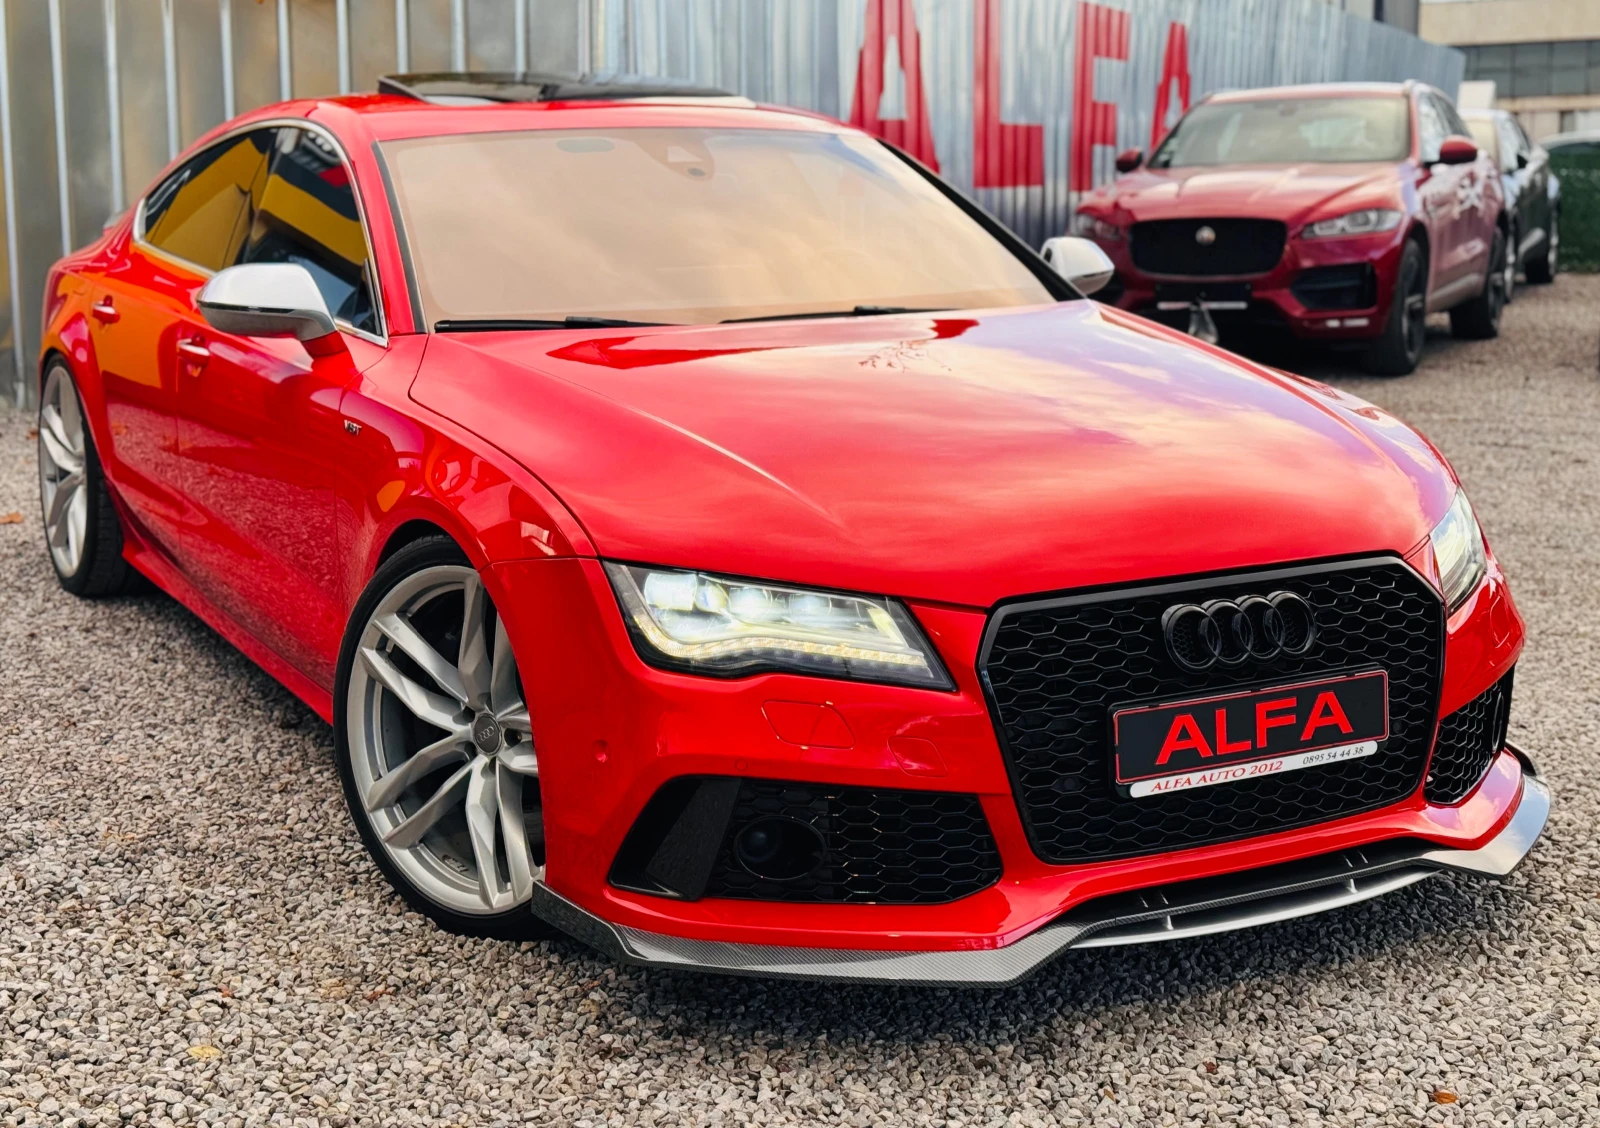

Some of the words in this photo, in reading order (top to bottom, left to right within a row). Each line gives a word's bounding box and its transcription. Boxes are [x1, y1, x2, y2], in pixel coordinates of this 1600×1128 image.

[850, 0, 1191, 191] ALFA
[1155, 691, 1354, 765] ALFA
[1151, 777, 1192, 792] ALFA
[1197, 768, 1246, 784] AUTO
[1249, 761, 1284, 775] 2012
[1302, 752, 1325, 765] 0895
[1326, 751, 1338, 761] 54
[1339, 748, 1352, 759] 44
[1353, 746, 1364, 756] 38
